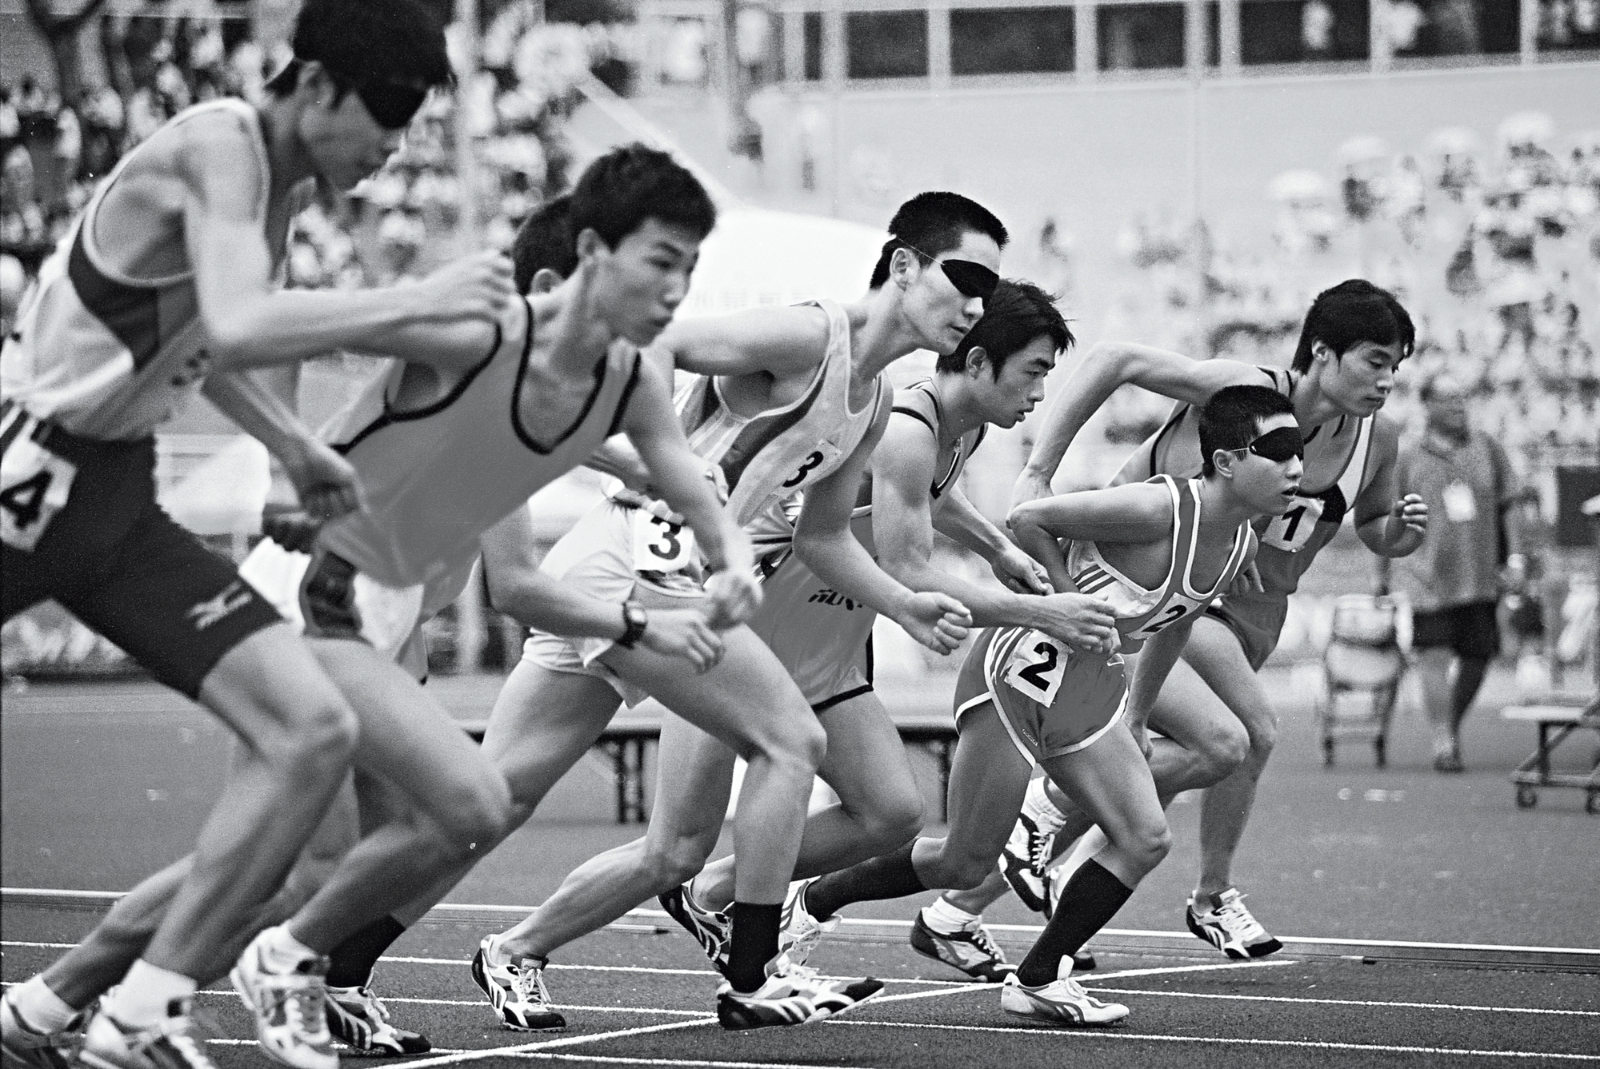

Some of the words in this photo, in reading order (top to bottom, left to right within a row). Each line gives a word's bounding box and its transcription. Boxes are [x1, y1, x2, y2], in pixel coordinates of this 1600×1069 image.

[782, 450, 824, 488] 3
[0, 467, 54, 528] 4
[648, 515, 681, 560] 3
[1281, 505, 1307, 542] 1
[1141, 604, 1187, 633] 2
[1017, 641, 1059, 692] 2
